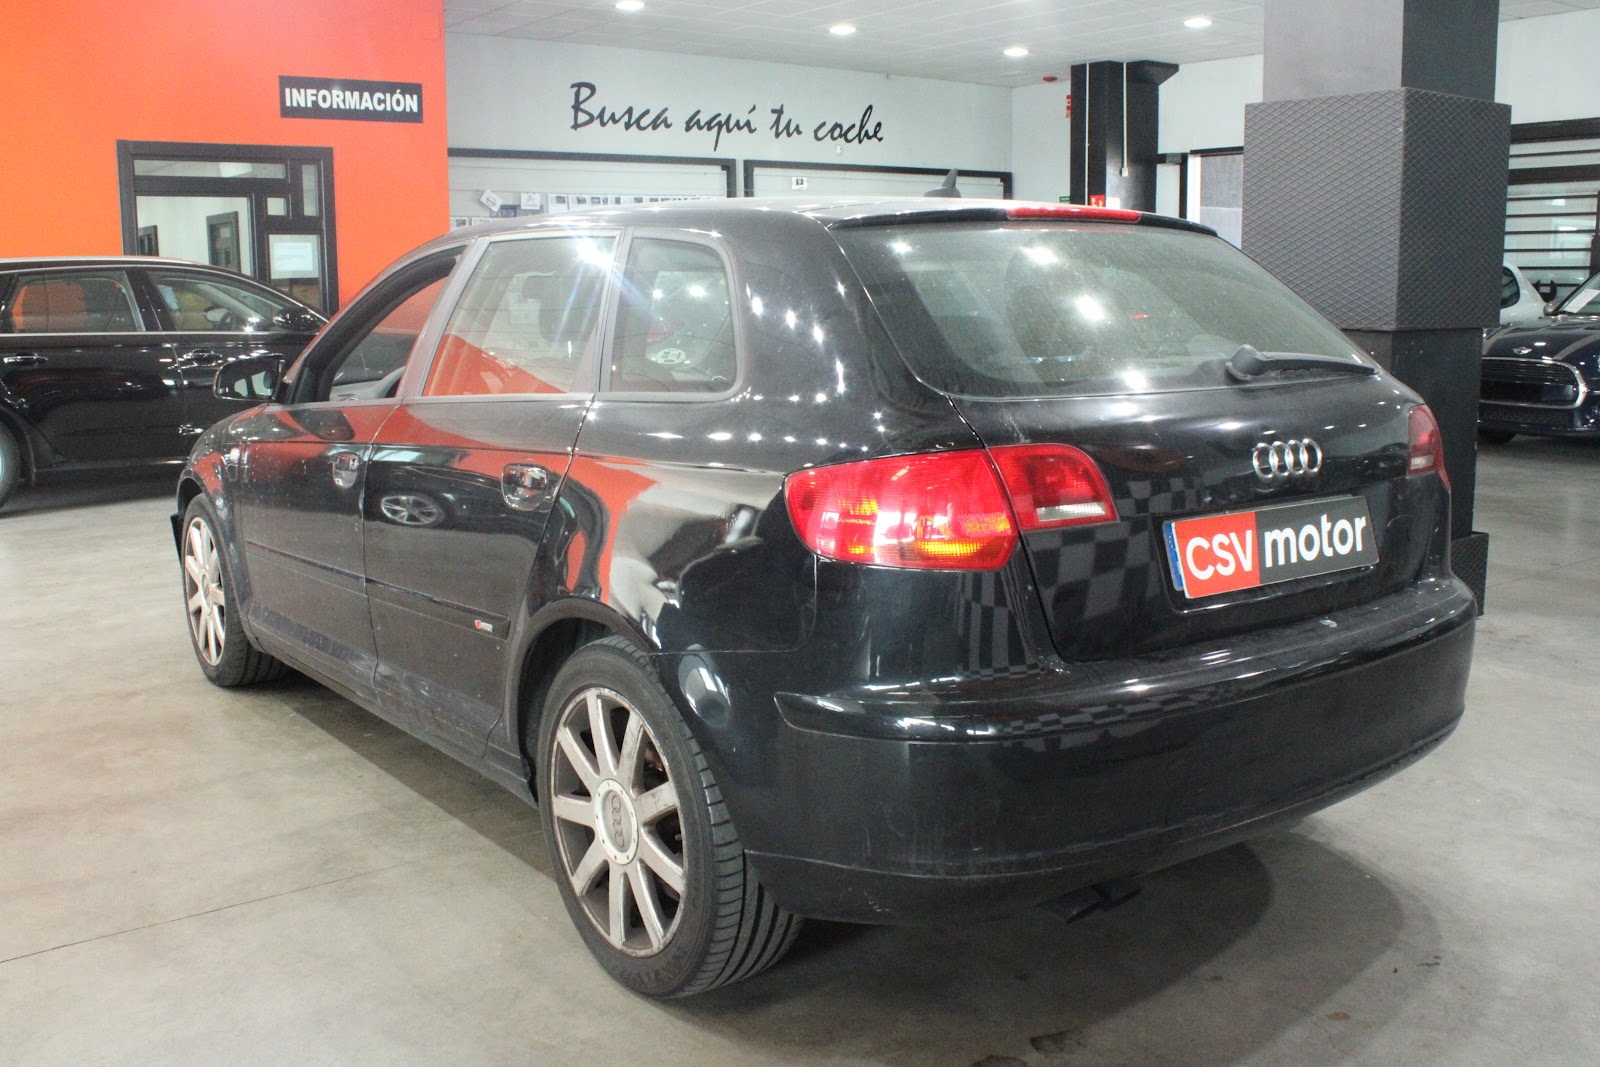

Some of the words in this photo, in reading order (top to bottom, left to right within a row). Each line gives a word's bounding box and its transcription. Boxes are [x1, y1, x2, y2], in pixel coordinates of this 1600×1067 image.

[284, 88, 418, 113] INFORMACIÓN
[570, 82, 673, 131] Busca
[685, 104, 757, 152] aquí
[770, 104, 803, 139] tu
[814, 104, 884, 145] coche
[1186, 530, 1253, 581] CSV
[1264, 514, 1367, 568] motor
